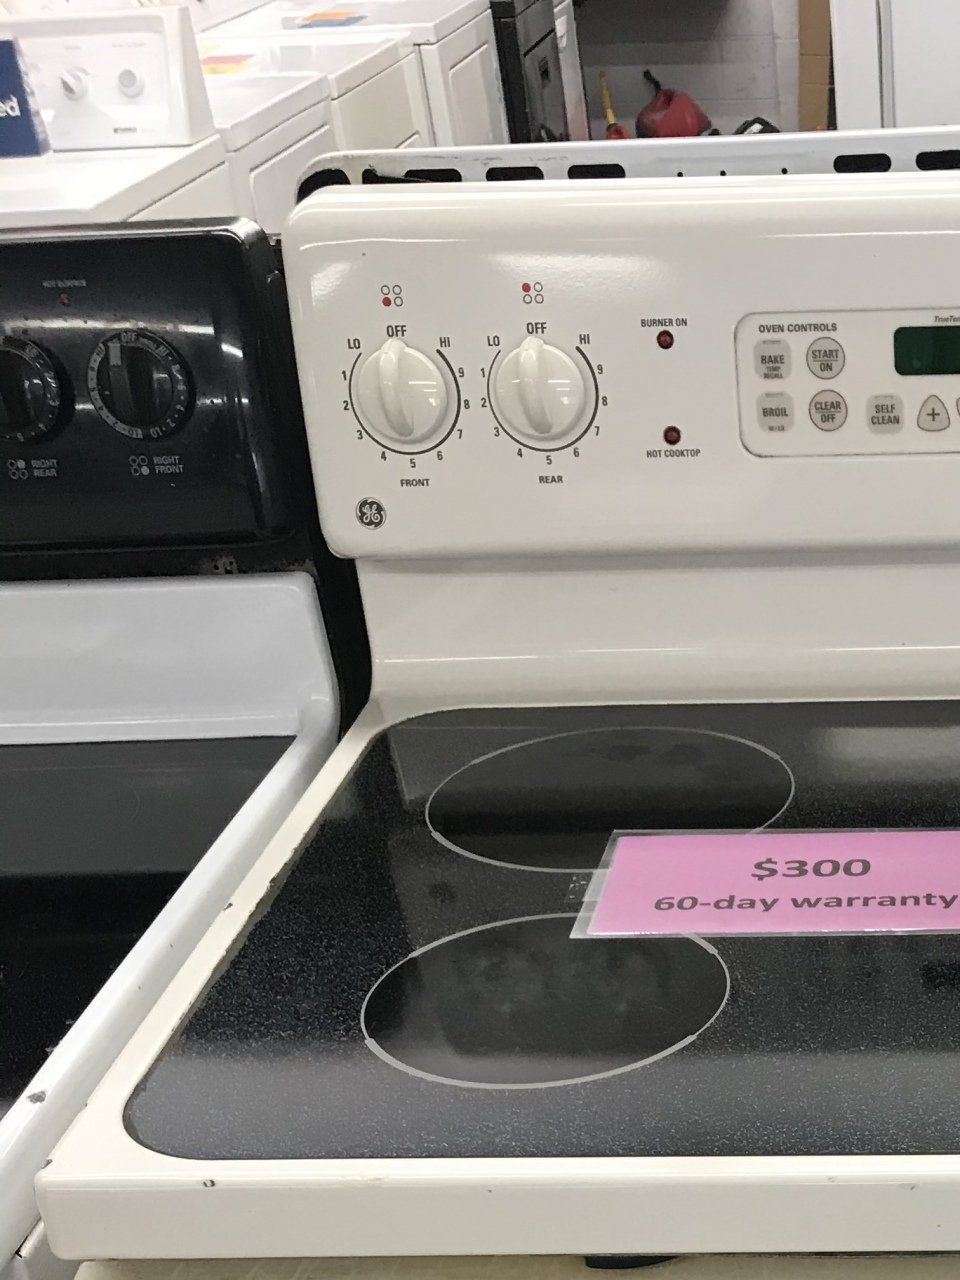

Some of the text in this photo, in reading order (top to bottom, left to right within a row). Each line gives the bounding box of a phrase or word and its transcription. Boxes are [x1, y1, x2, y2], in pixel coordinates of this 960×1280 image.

[640, 318, 688, 327] BURNER ON
[758, 323, 837, 333] OVEN CONTROLS
[386, 325, 407, 338] OFF
[526, 322, 547, 335] OFF
[347, 338, 361, 350] LO
[439, 336, 451, 348] HI
[487, 335, 500, 347] LO
[579, 334, 591, 345] HI
[761, 354, 784, 364] BAKE
[811, 350, 839, 359] START
[458, 367, 465, 378] 9
[480, 367, 486, 378] 1
[597, 364, 604, 375] 9
[820, 363, 833, 372] ON
[341, 370, 348, 381] 1
[343, 400, 350, 411] 2
[463, 399, 471, 410] 8
[481, 397, 488, 408] 2
[601, 396, 608, 407] 8
[814, 401, 841, 410] CLEAR
[762, 407, 788, 417] BROIL
[875, 404, 896, 414] SELF
[821, 414, 836, 423] OFF
[871, 415, 900, 425] CLEAN
[357, 430, 364, 440] 3
[457, 429, 463, 440] 7
[493, 426, 500, 437] 3
[594, 426, 600, 437] 7
[380, 451, 387, 462] 4
[437, 450, 444, 461] 6
[516, 448, 523, 458] 4
[573, 447, 580, 458] 6
[646, 449, 701, 458] HOT COOKTOP
[153, 456, 180, 464] RIGHT
[410, 458, 416, 469] 5
[546, 455, 552, 465] 5
[155, 465, 184, 474] FRONT
[400, 478, 430, 488] FRONT
[538, 475, 563, 484] REAR
[751, 858, 871, 881] $300
[654, 893, 959, 912] 60-day warranty
